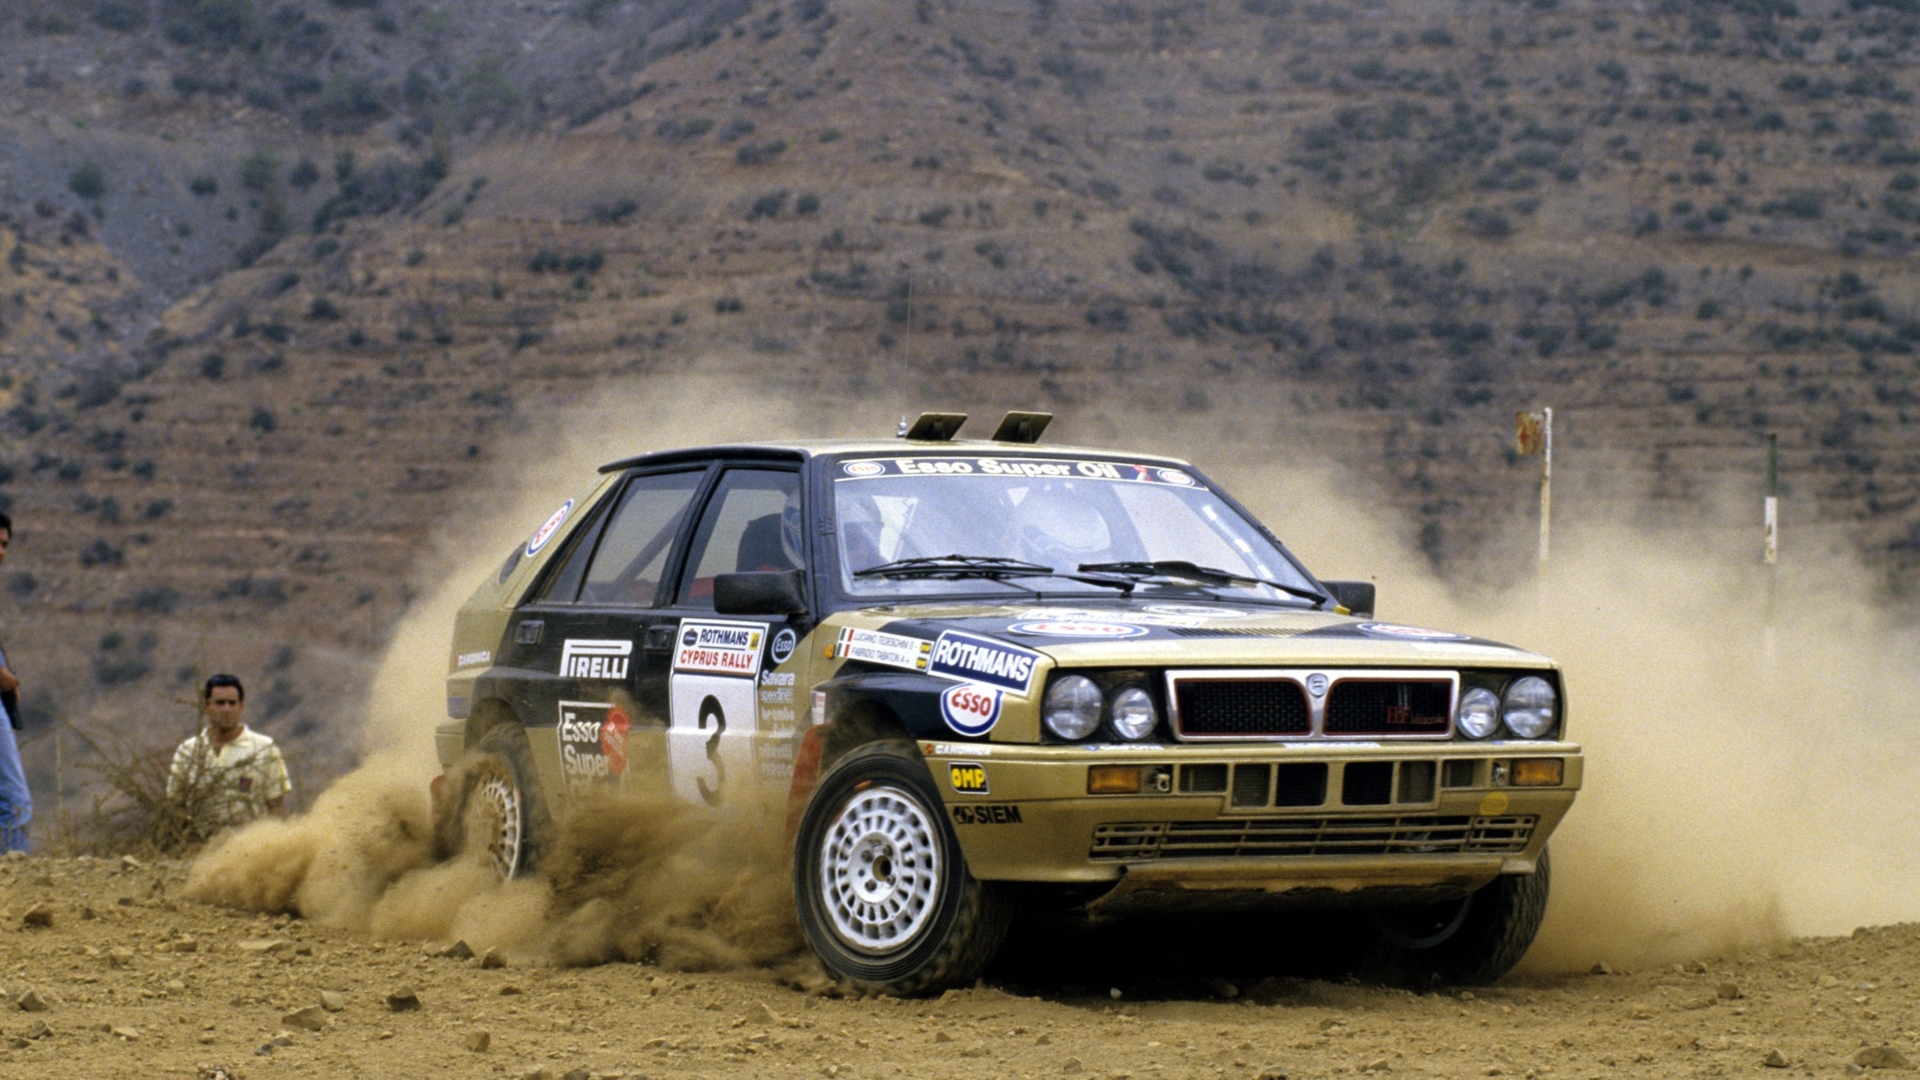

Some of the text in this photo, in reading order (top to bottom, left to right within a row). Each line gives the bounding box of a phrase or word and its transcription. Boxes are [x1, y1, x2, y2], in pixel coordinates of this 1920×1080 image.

[895, 458, 1121, 478] Esso Super Oil
[700, 628, 749, 646] ROTHMANS
[775, 638, 792, 653] Esso
[559, 639, 633, 679] PIRELLI
[680, 649, 754, 669] CYPRUS RALLY
[935, 639, 1032, 682] ROTHMANS
[761, 669, 795, 686] Savara
[562, 712, 601, 742] Esso
[696, 693, 726, 807] 3
[564, 744, 610, 780] Super
[951, 768, 986, 788] OMP
[974, 805, 1023, 824] SIEM
